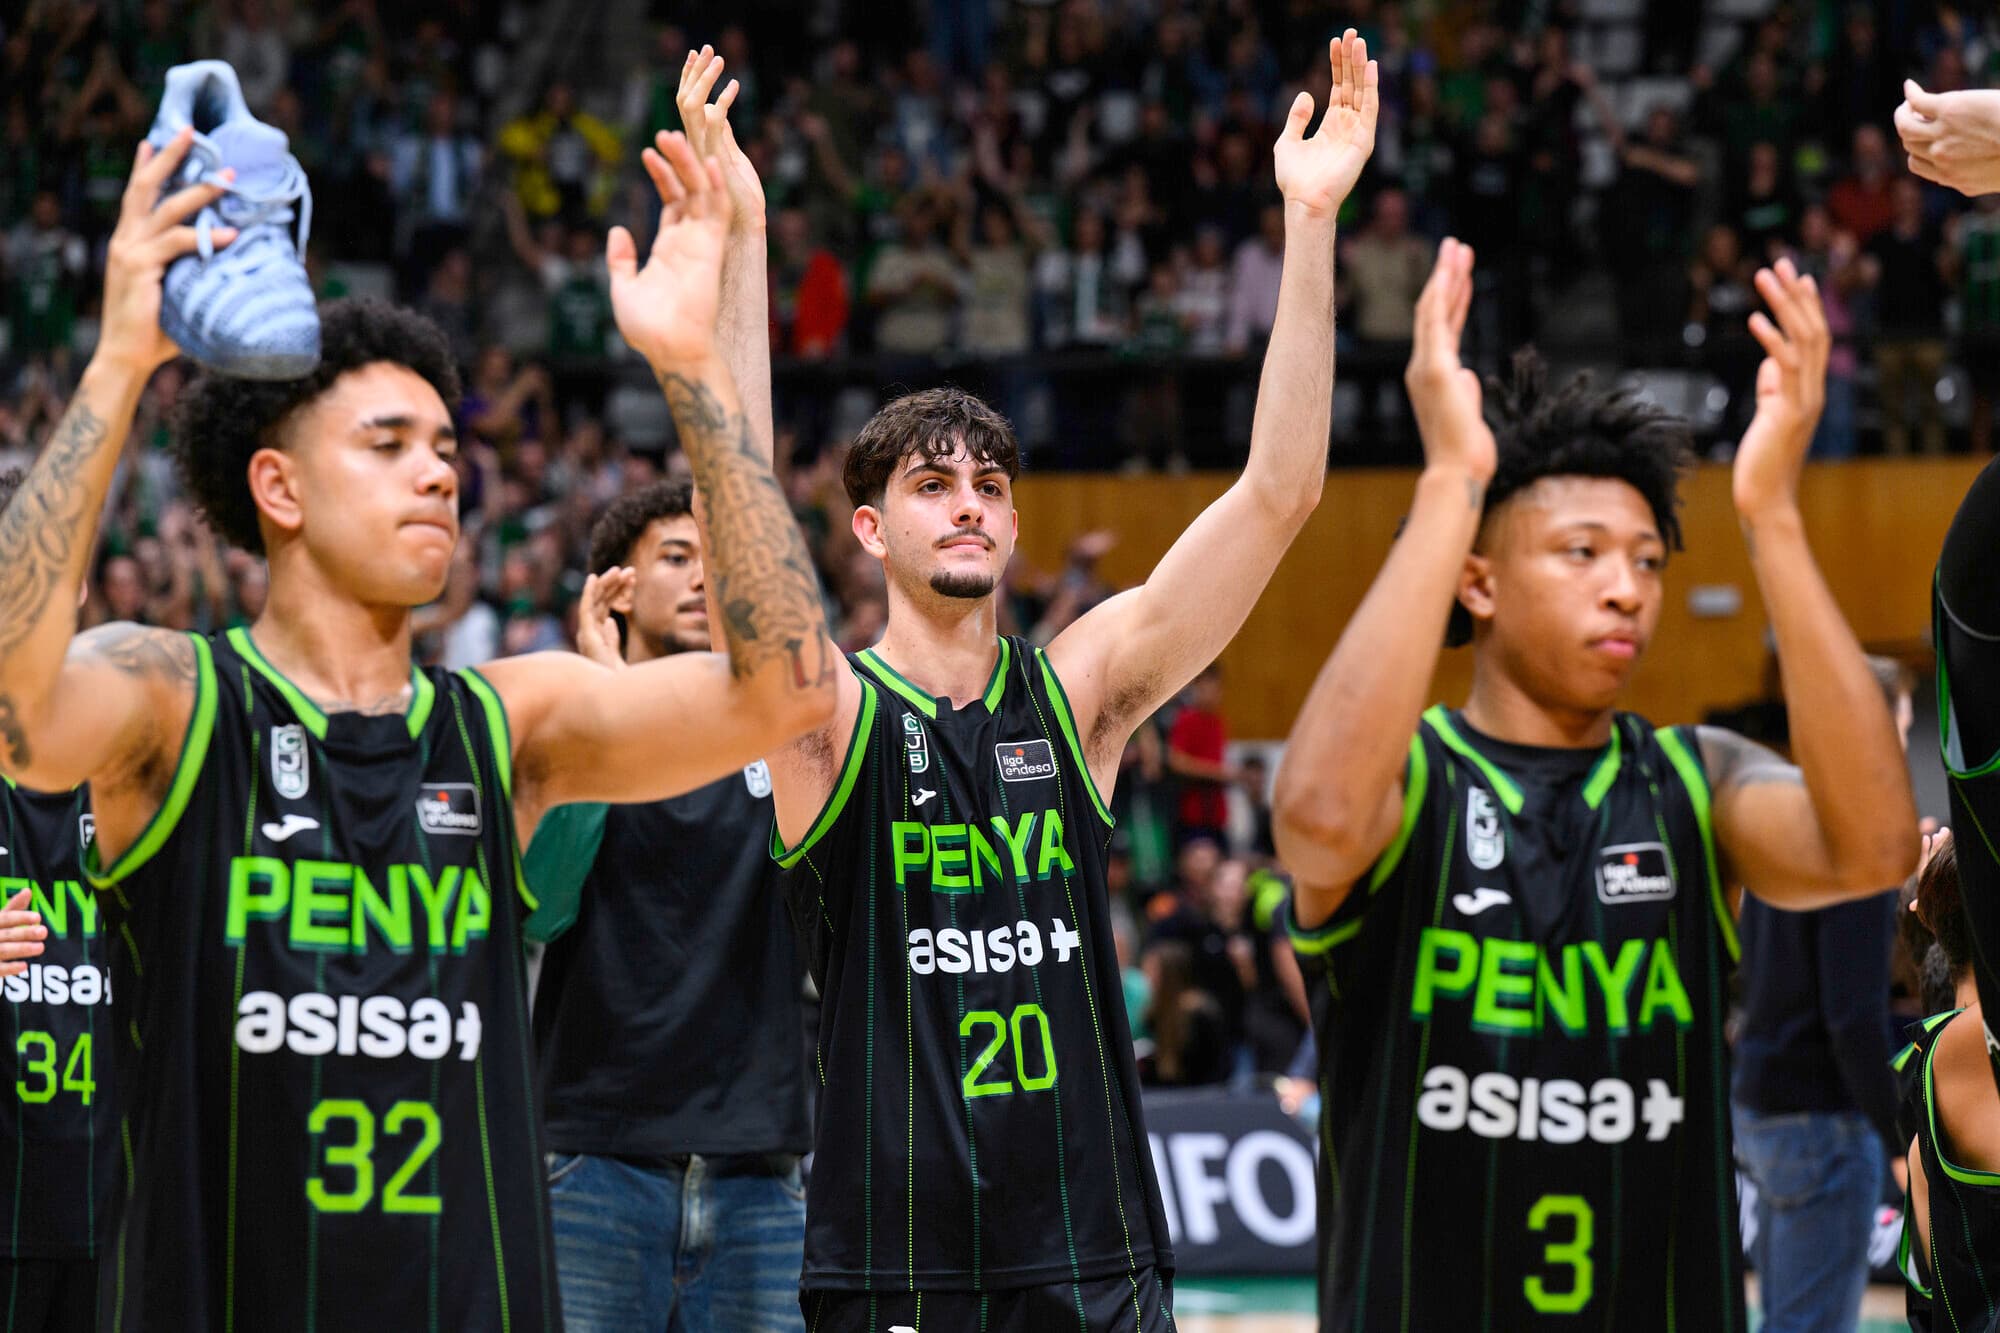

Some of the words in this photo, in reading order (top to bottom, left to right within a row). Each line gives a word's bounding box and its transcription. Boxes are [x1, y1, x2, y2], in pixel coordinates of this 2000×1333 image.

[1002, 755, 1024, 767] liga
[1005, 763, 1051, 776] endesa
[891, 808, 1075, 892] PENYA
[226, 856, 492, 952] PENYA
[0, 963, 102, 1006] sisa
[1412, 929, 1693, 1035] PENYA
[16, 1031, 96, 1106] 34
[959, 1003, 1058, 1098] 20
[306, 1100, 442, 1214] 32
[1524, 1196, 1594, 1313] 3
